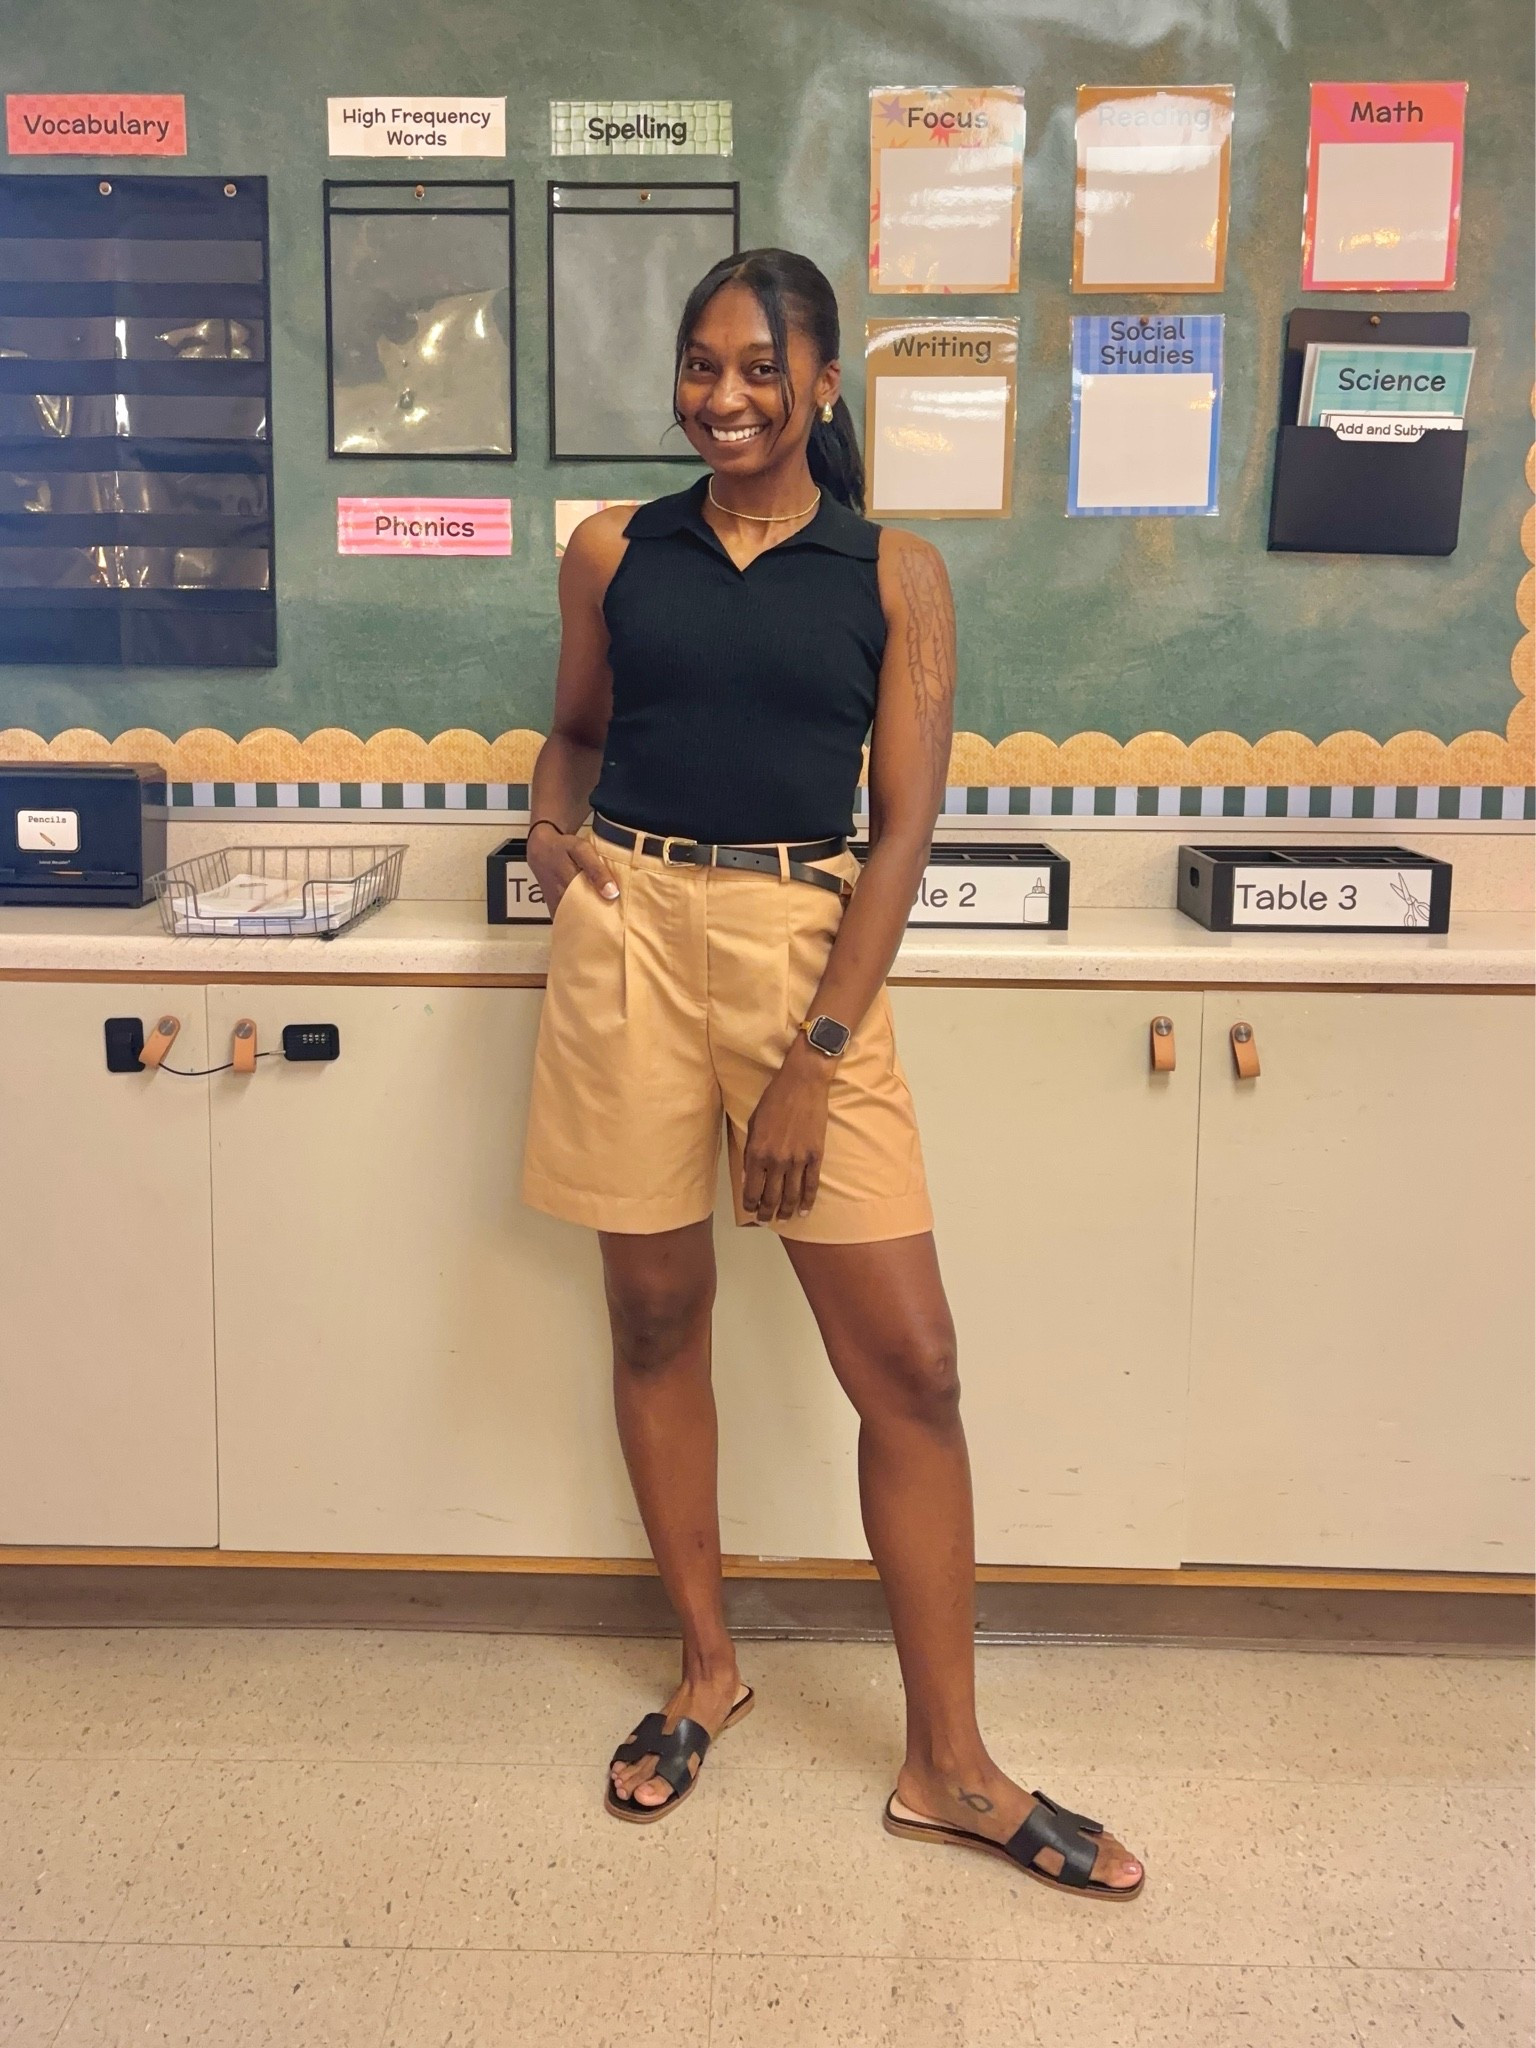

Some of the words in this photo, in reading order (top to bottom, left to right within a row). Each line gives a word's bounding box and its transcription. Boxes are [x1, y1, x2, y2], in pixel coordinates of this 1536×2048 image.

[342, 108, 386, 125] High
[391, 108, 491, 128] Frequency
[907, 107, 989, 129] Focus
[1099, 106, 1211, 130] Reading
[1350, 100, 1424, 124] Math
[23, 111, 170, 142] Vocabulary
[386, 130, 447, 147] Words
[587, 114, 687, 146] Spelling
[1110, 318, 1186, 341] Social
[893, 334, 992, 363] Writing
[1100, 345, 1195, 365] Studies
[1338, 367, 1446, 392] Science
[1336, 422, 1363, 435] Add
[1366, 423, 1391, 436] and
[375, 516, 475, 538] Phonics
[27, 815, 67, 824] Pencils
[508, 878, 546, 904] Ta
[912, 877, 948, 908] le
[958, 882, 977, 908] 2
[1236, 880, 1328, 911] Table
[1338, 885, 1358, 911] 3
